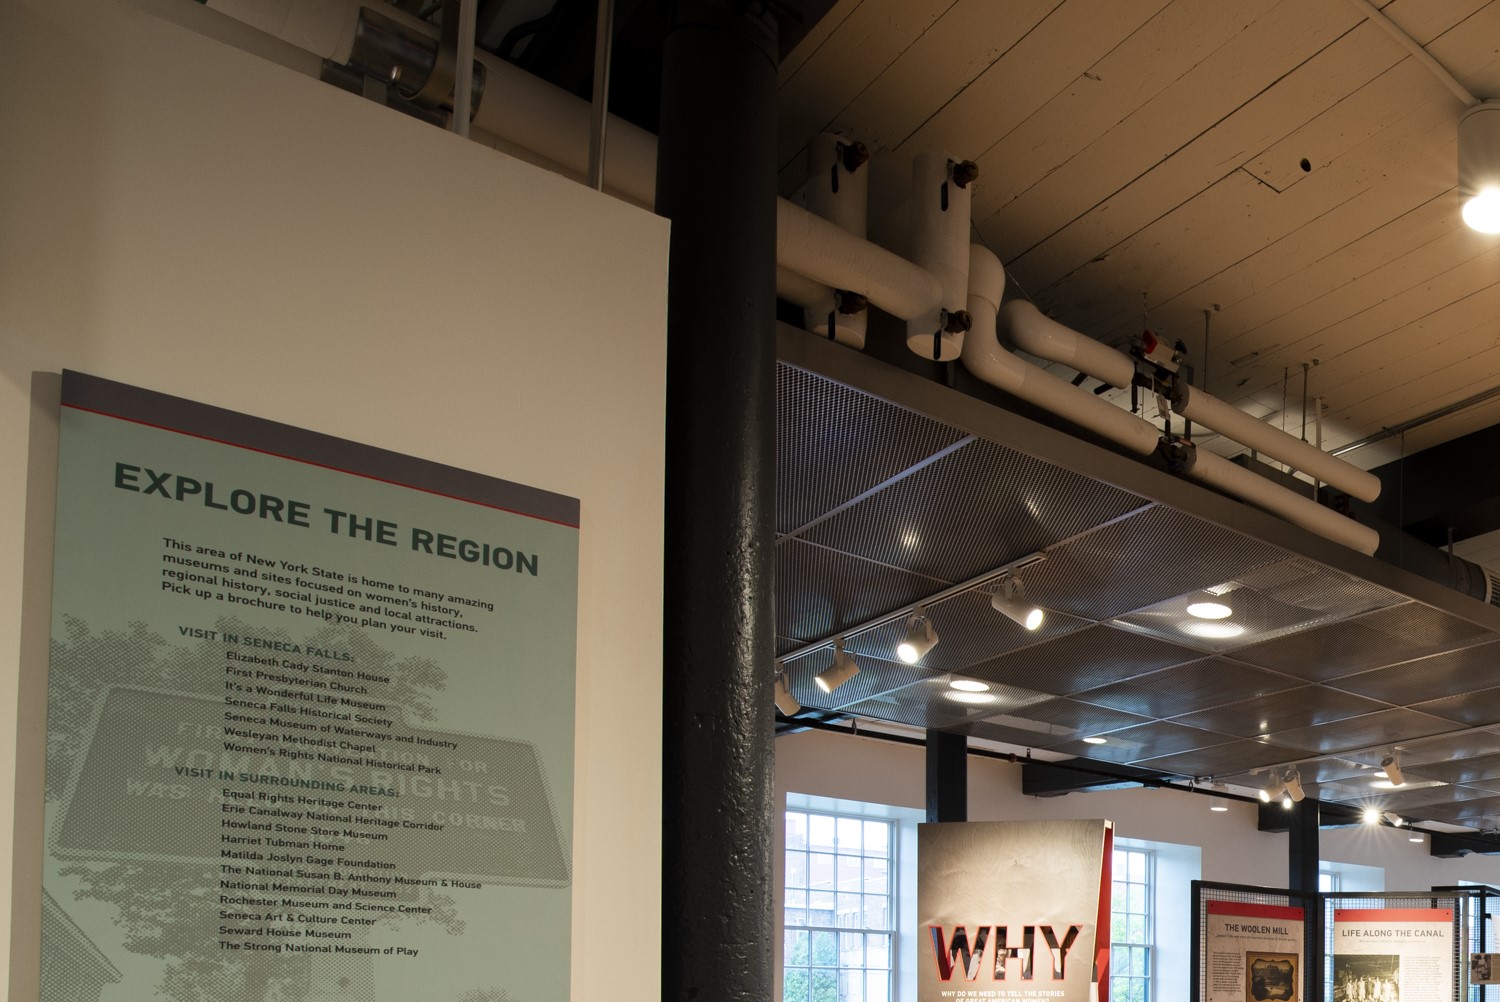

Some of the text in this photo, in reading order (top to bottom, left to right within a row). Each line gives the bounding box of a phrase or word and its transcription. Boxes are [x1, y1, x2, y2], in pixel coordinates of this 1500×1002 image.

[115, 462, 538, 577] EXPLORE THE REGION
[163, 538, 494, 612] This area of New York State is home to many amazing
[163, 555, 463, 618] museums and sites focused on women's history,
[162, 569, 478, 632] regional history, social justice and local attractions.
[162, 581, 191, 595] Pick
[196, 589, 212, 600] up
[228, 592, 286, 612] brochure
[290, 605, 302, 614] to
[306, 606, 333, 621] help
[336, 612, 358, 624] you
[362, 618, 387, 629] plan
[390, 624, 417, 634] your
[420, 628, 446, 640] visit.
[179, 626, 354, 663] VISIT IN SENECA FALLS:
[226, 651, 390, 684] Elizabeth Cady Stanton House
[175, 766, 401, 798] VISIT IN SURROUNDING AREAS:
[222, 834, 345, 852] Harriet Tubman Home
[219, 926, 352, 939] Seward House Museum
[1225, 924, 1289, 935] THE WOOLEN MILL
[928, 925, 1084, 982] WHY
